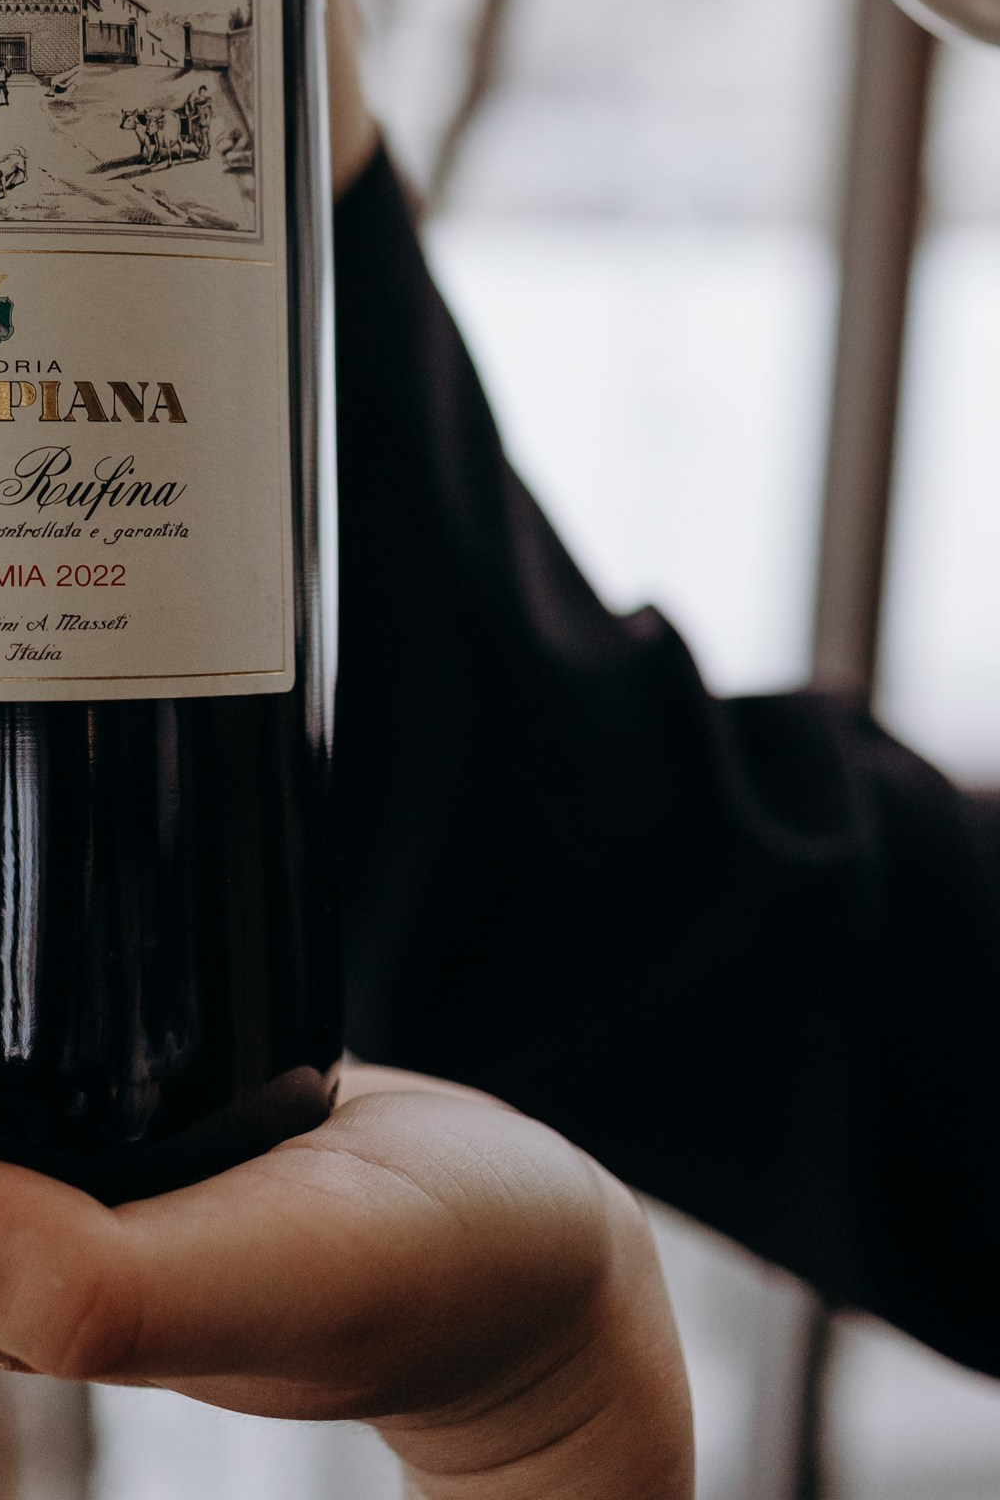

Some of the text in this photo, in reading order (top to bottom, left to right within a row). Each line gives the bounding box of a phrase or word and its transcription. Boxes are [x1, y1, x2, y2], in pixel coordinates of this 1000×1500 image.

[89, 527, 100, 539] e
[103, 521, 190, 545] garantita
[56, 564, 127, 588] 2022
[4, 643, 63, 662] Italia
